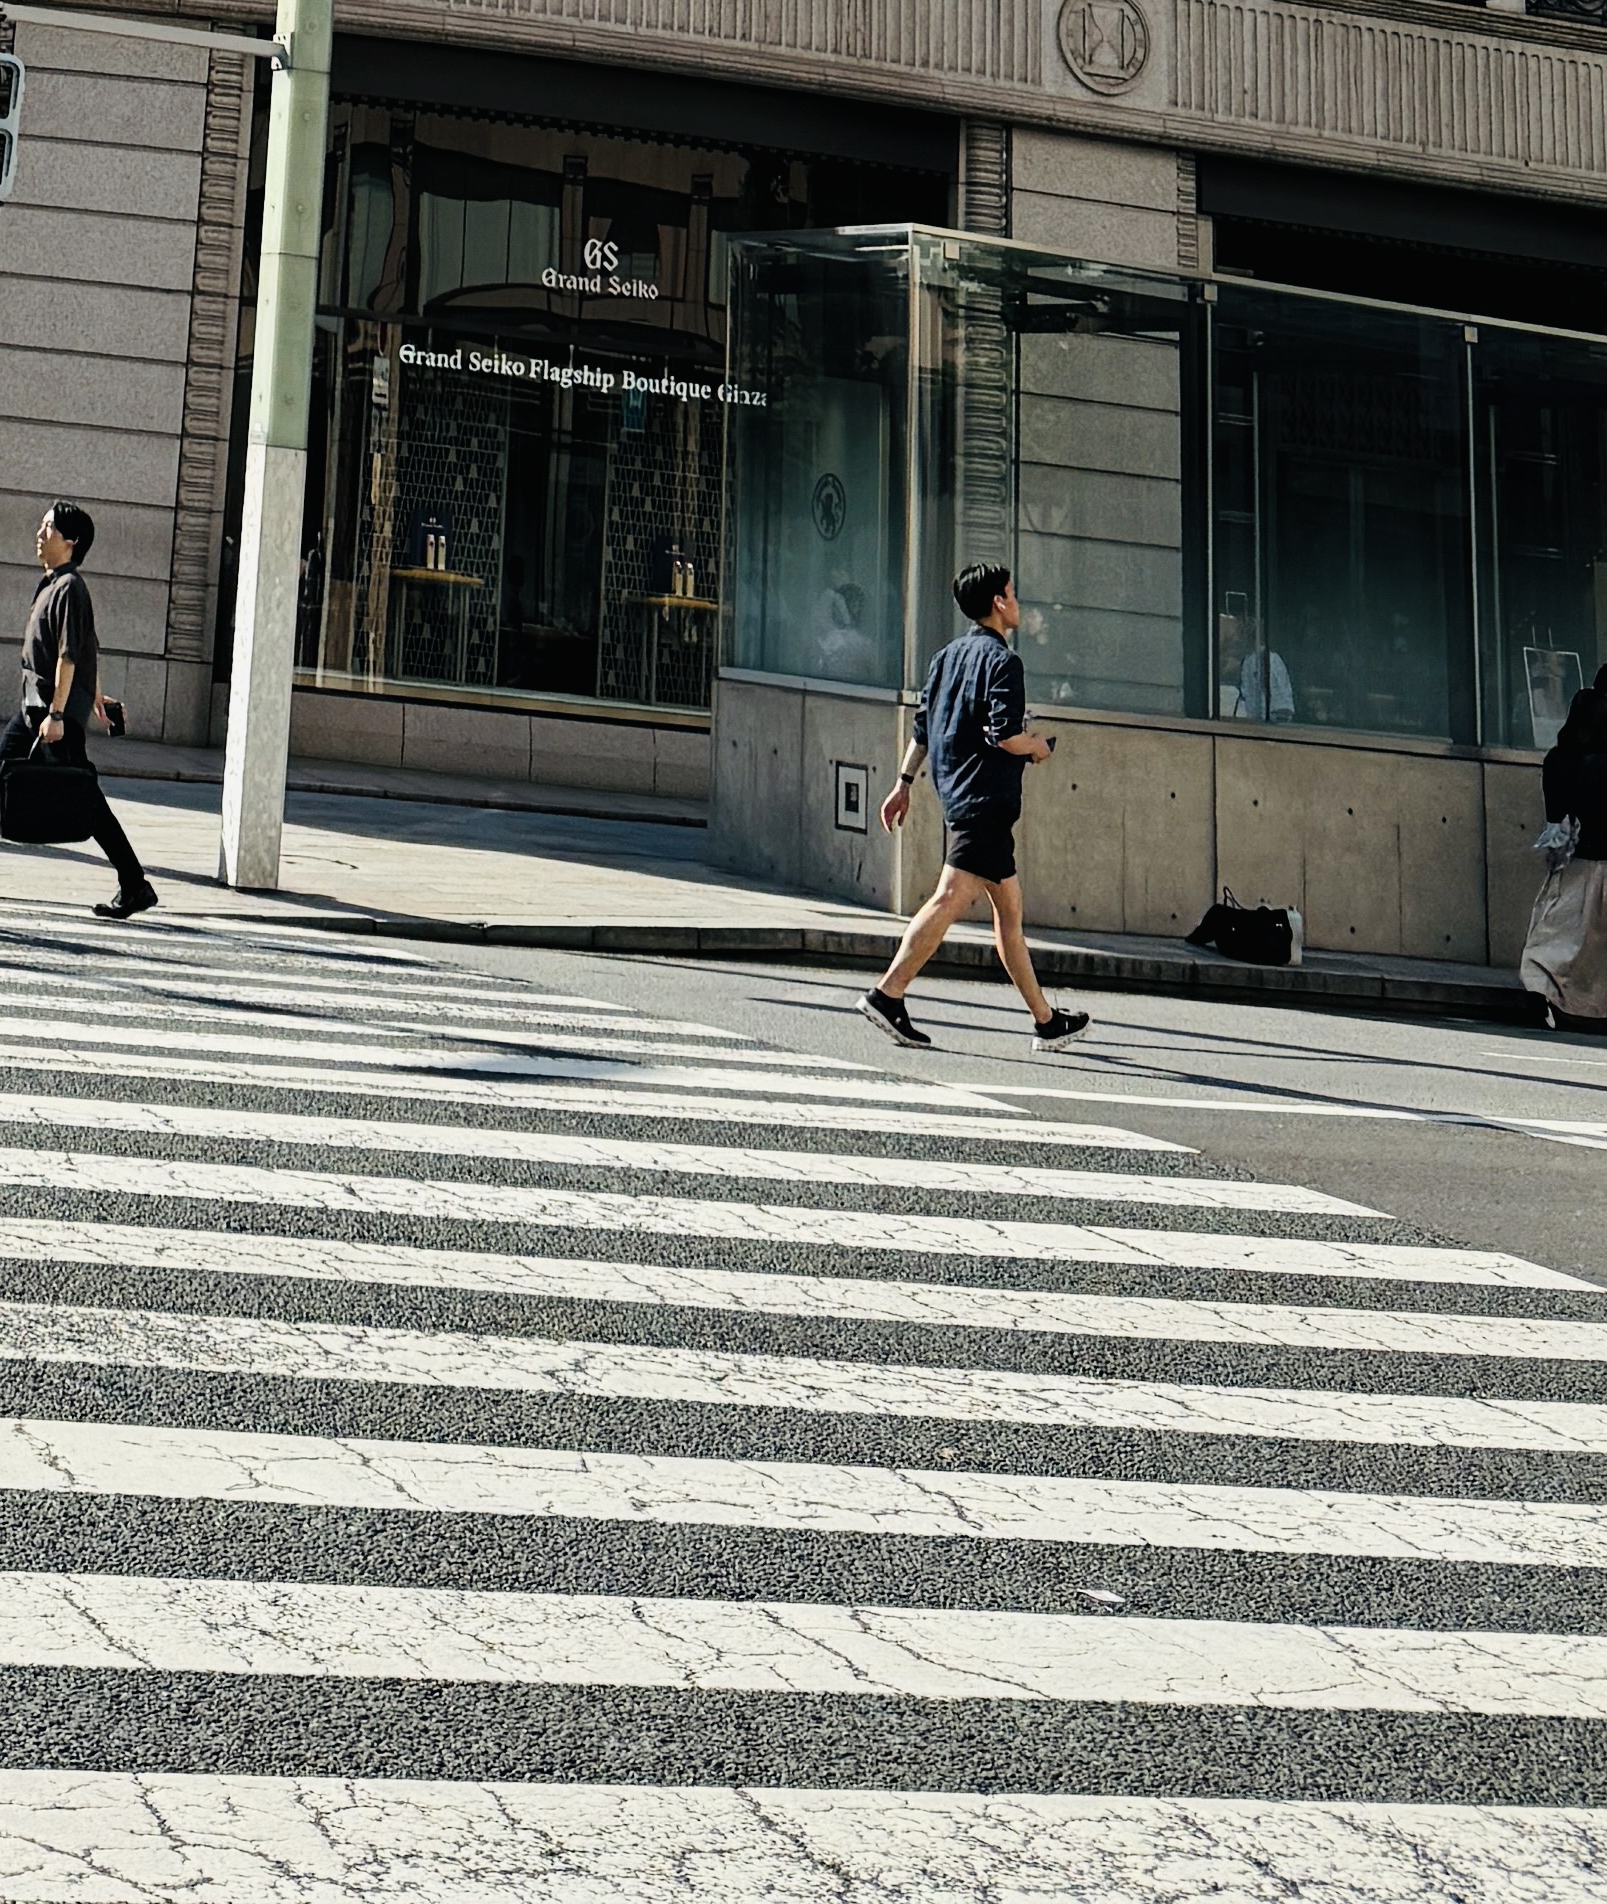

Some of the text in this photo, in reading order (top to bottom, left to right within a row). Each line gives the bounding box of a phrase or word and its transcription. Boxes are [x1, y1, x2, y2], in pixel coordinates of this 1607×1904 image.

[583, 238, 619, 272] GS
[541, 266, 659, 300] Grand Seiko
[399, 344, 462, 370] Grand
[468, 351, 526, 377] Seiko
[528, 358, 616, 394] Flagship
[622, 370, 712, 403] Boutique
